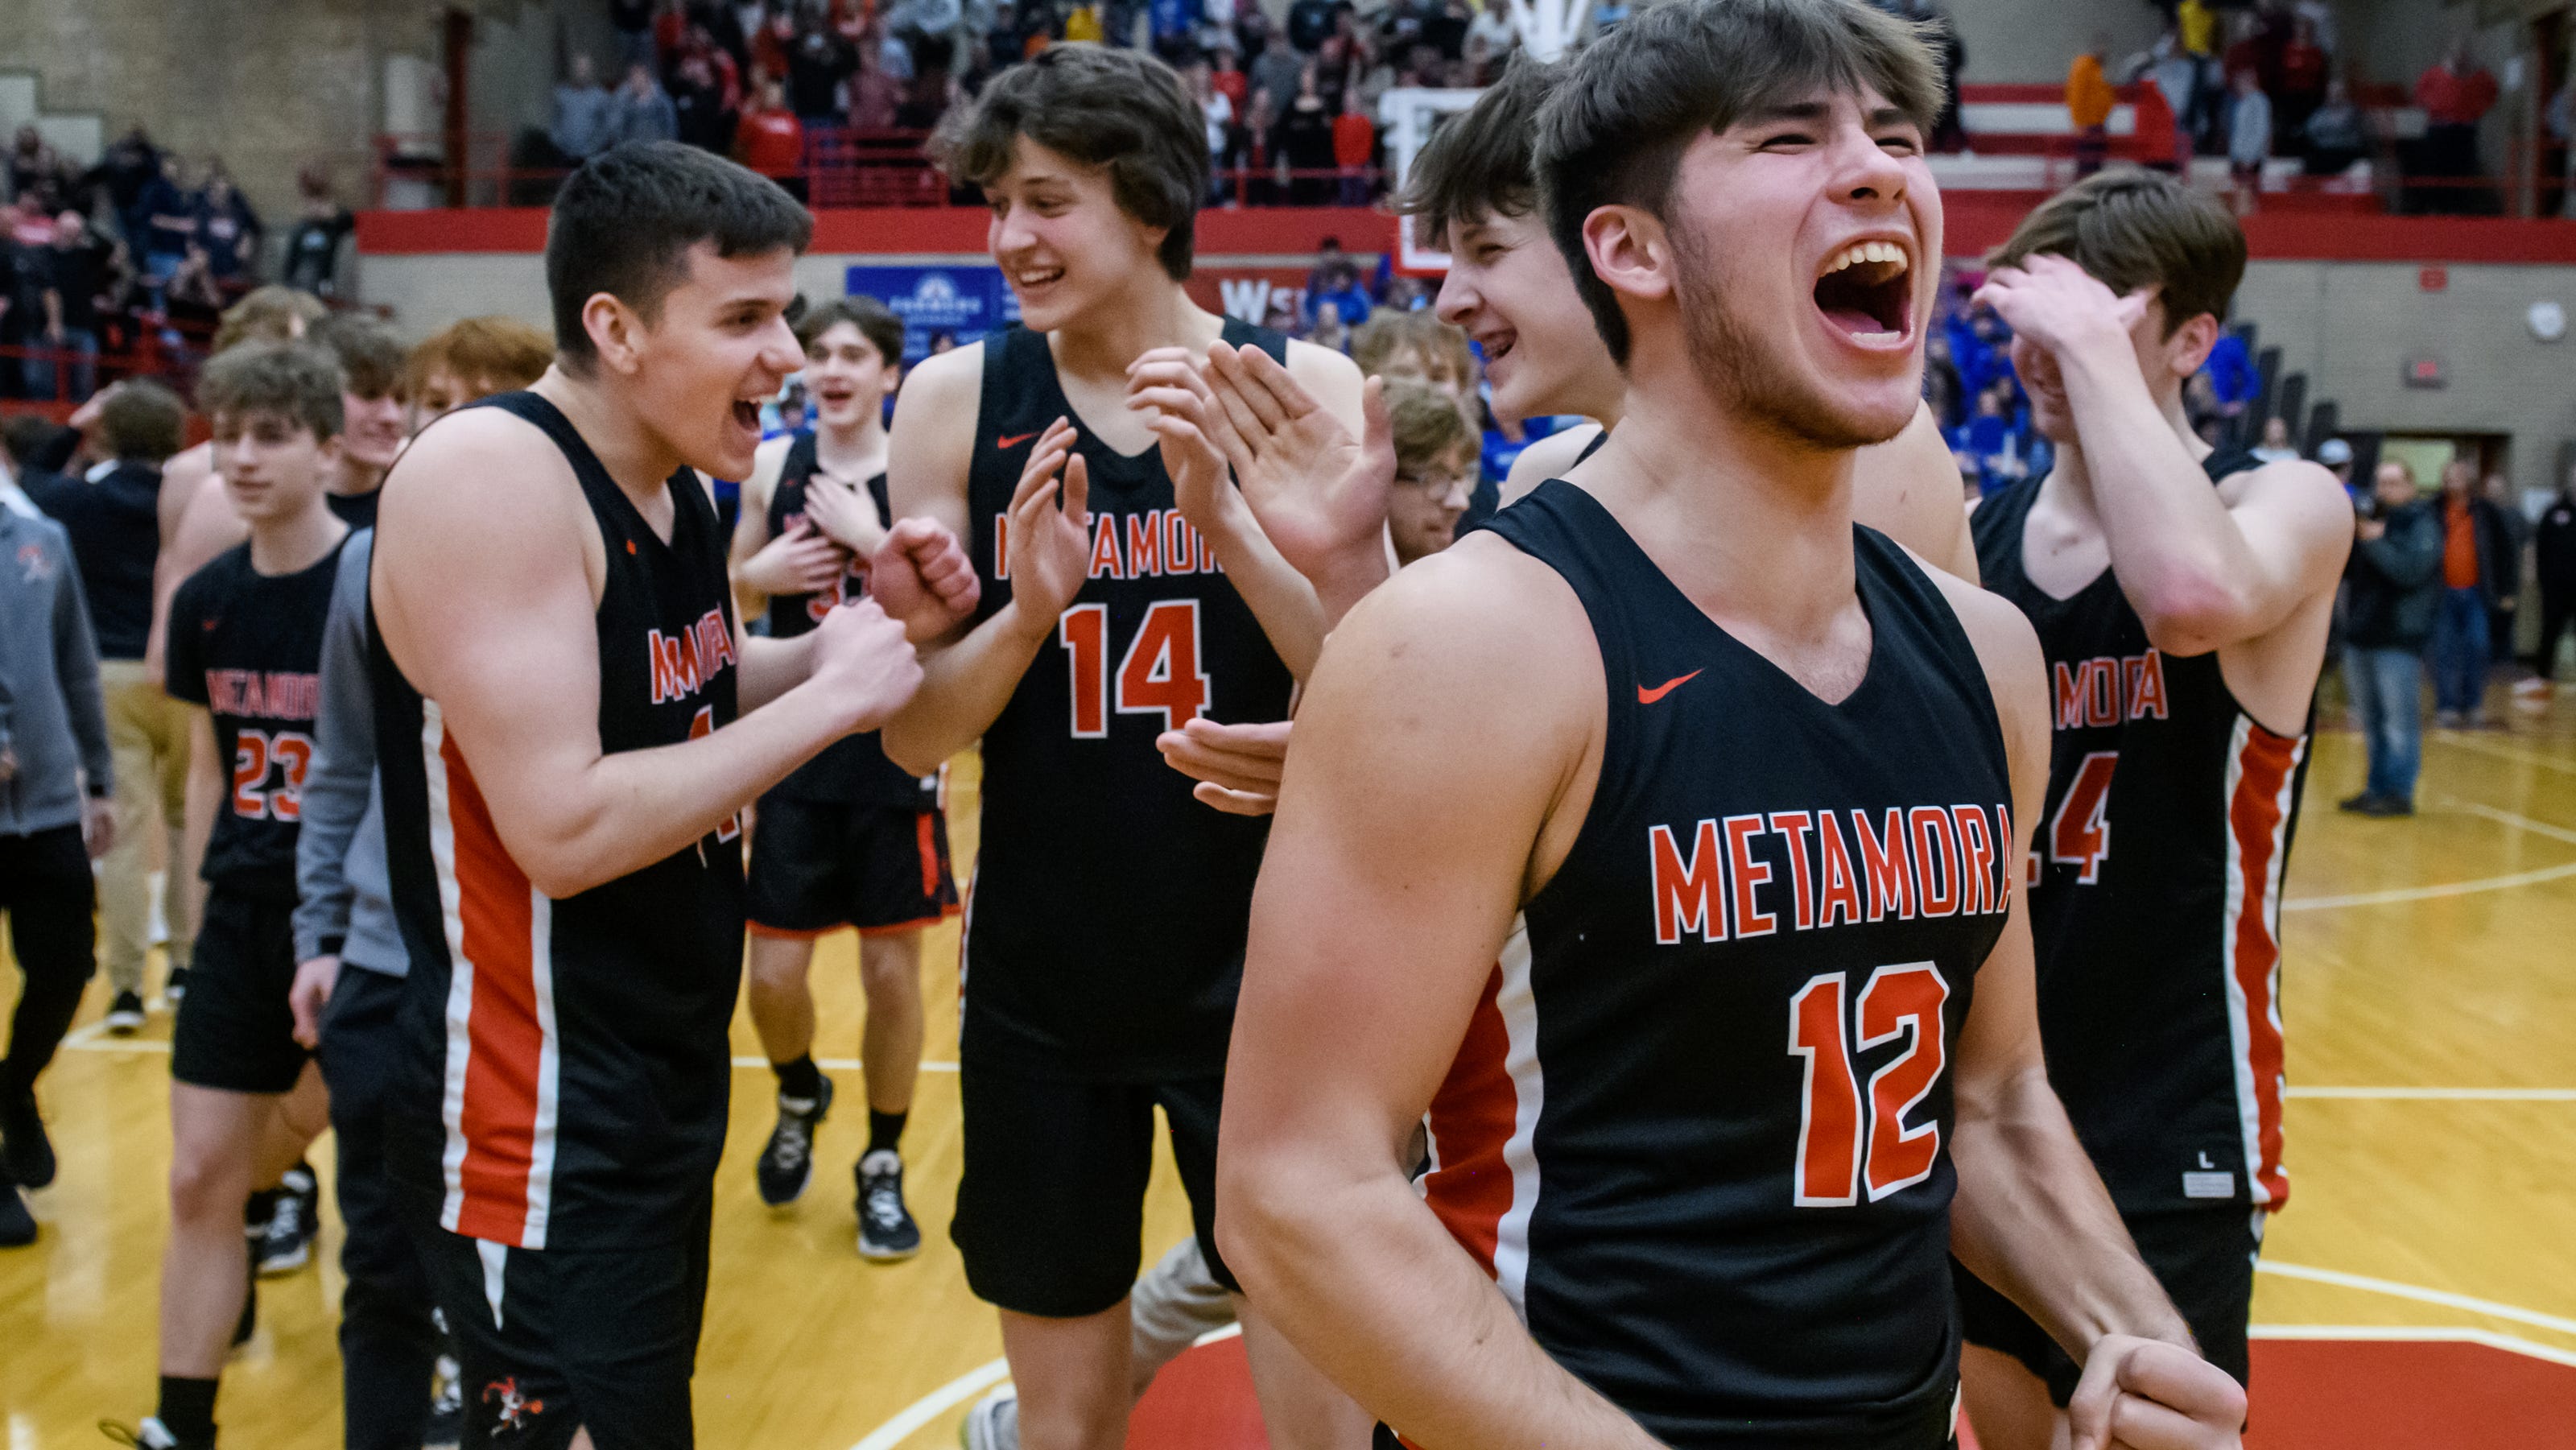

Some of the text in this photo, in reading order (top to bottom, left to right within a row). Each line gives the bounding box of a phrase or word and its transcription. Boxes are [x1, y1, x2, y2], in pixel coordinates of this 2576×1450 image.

[1059, 598, 1212, 739] 14
[2054, 647, 2169, 730] MORA
[233, 728, 313, 823] 23
[2027, 750, 2119, 888] 4
[1787, 960, 1950, 1208] 12
[2198, 1150, 2215, 1170] L
